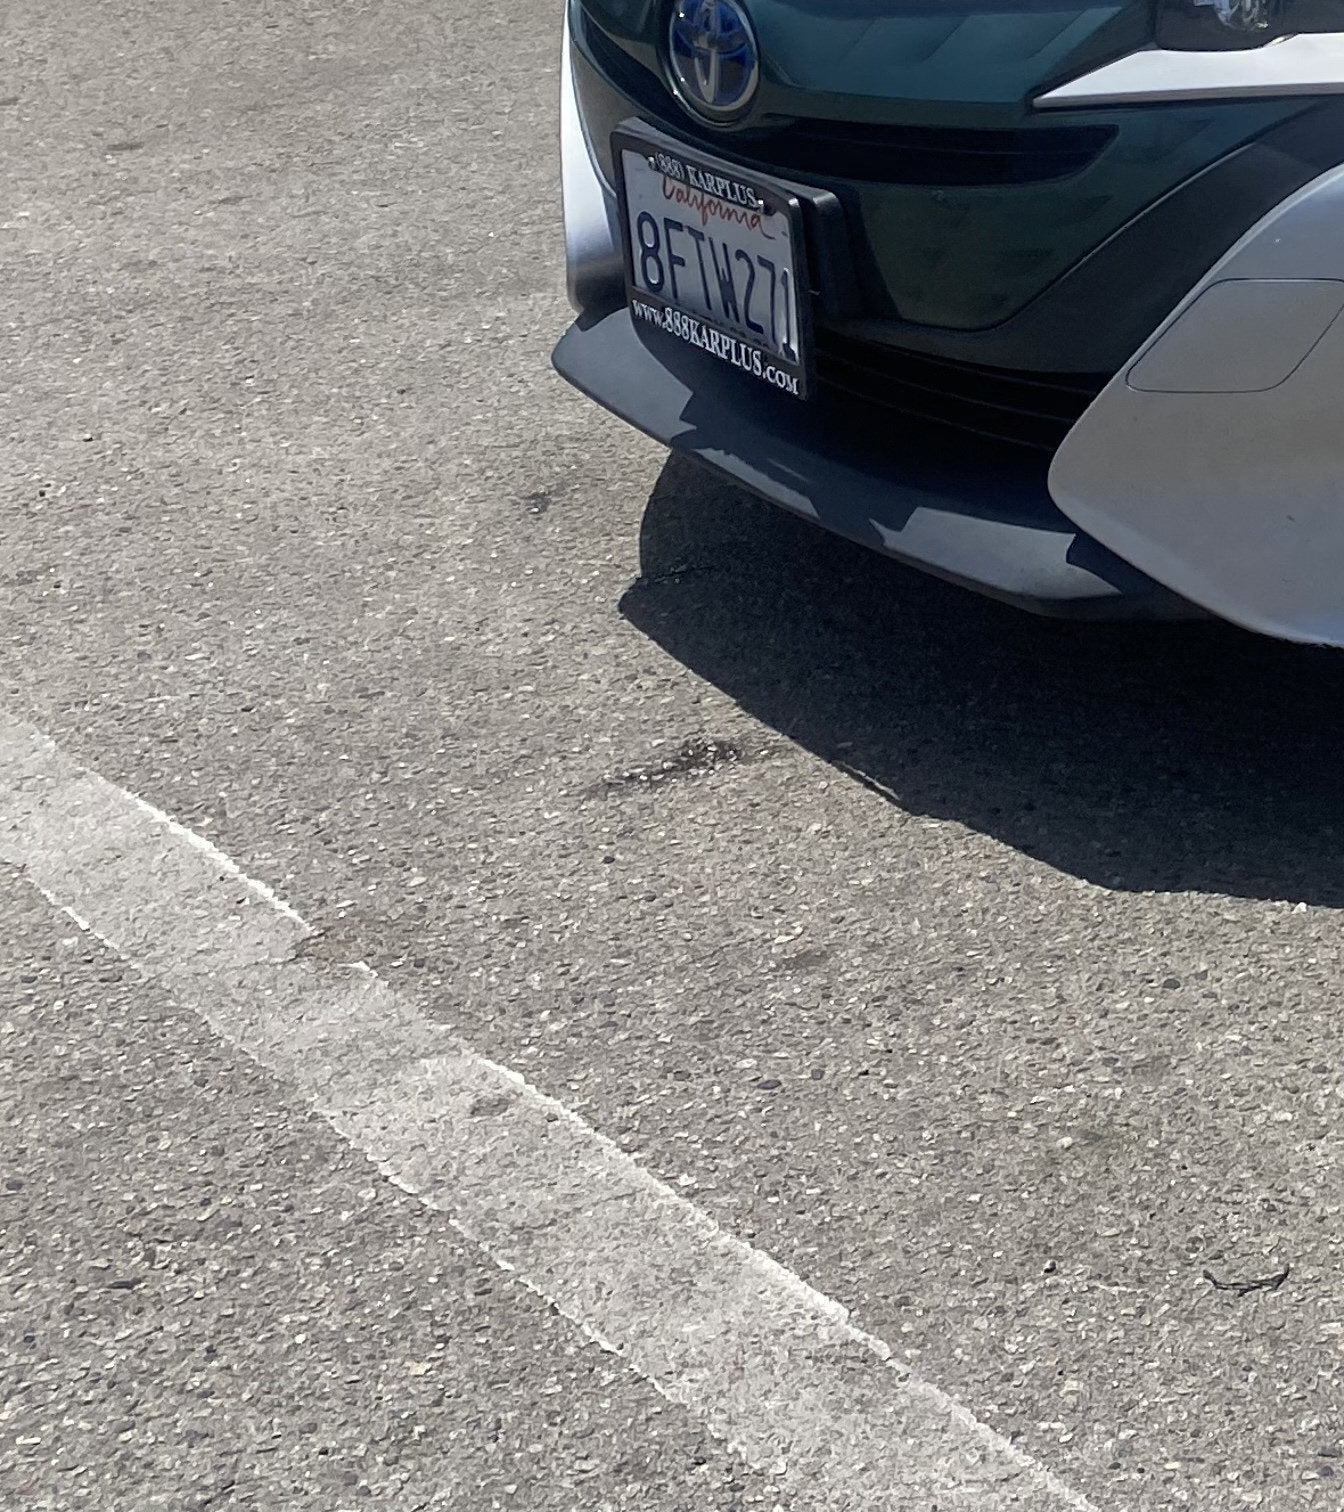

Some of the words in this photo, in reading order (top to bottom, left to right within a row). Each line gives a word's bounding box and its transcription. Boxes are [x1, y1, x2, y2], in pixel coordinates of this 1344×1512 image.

[655, 152, 685, 181] (888)
[686, 164, 760, 208] KARPLUS
[662, 174, 776, 241] California
[636, 211, 798, 362] 8FTW271
